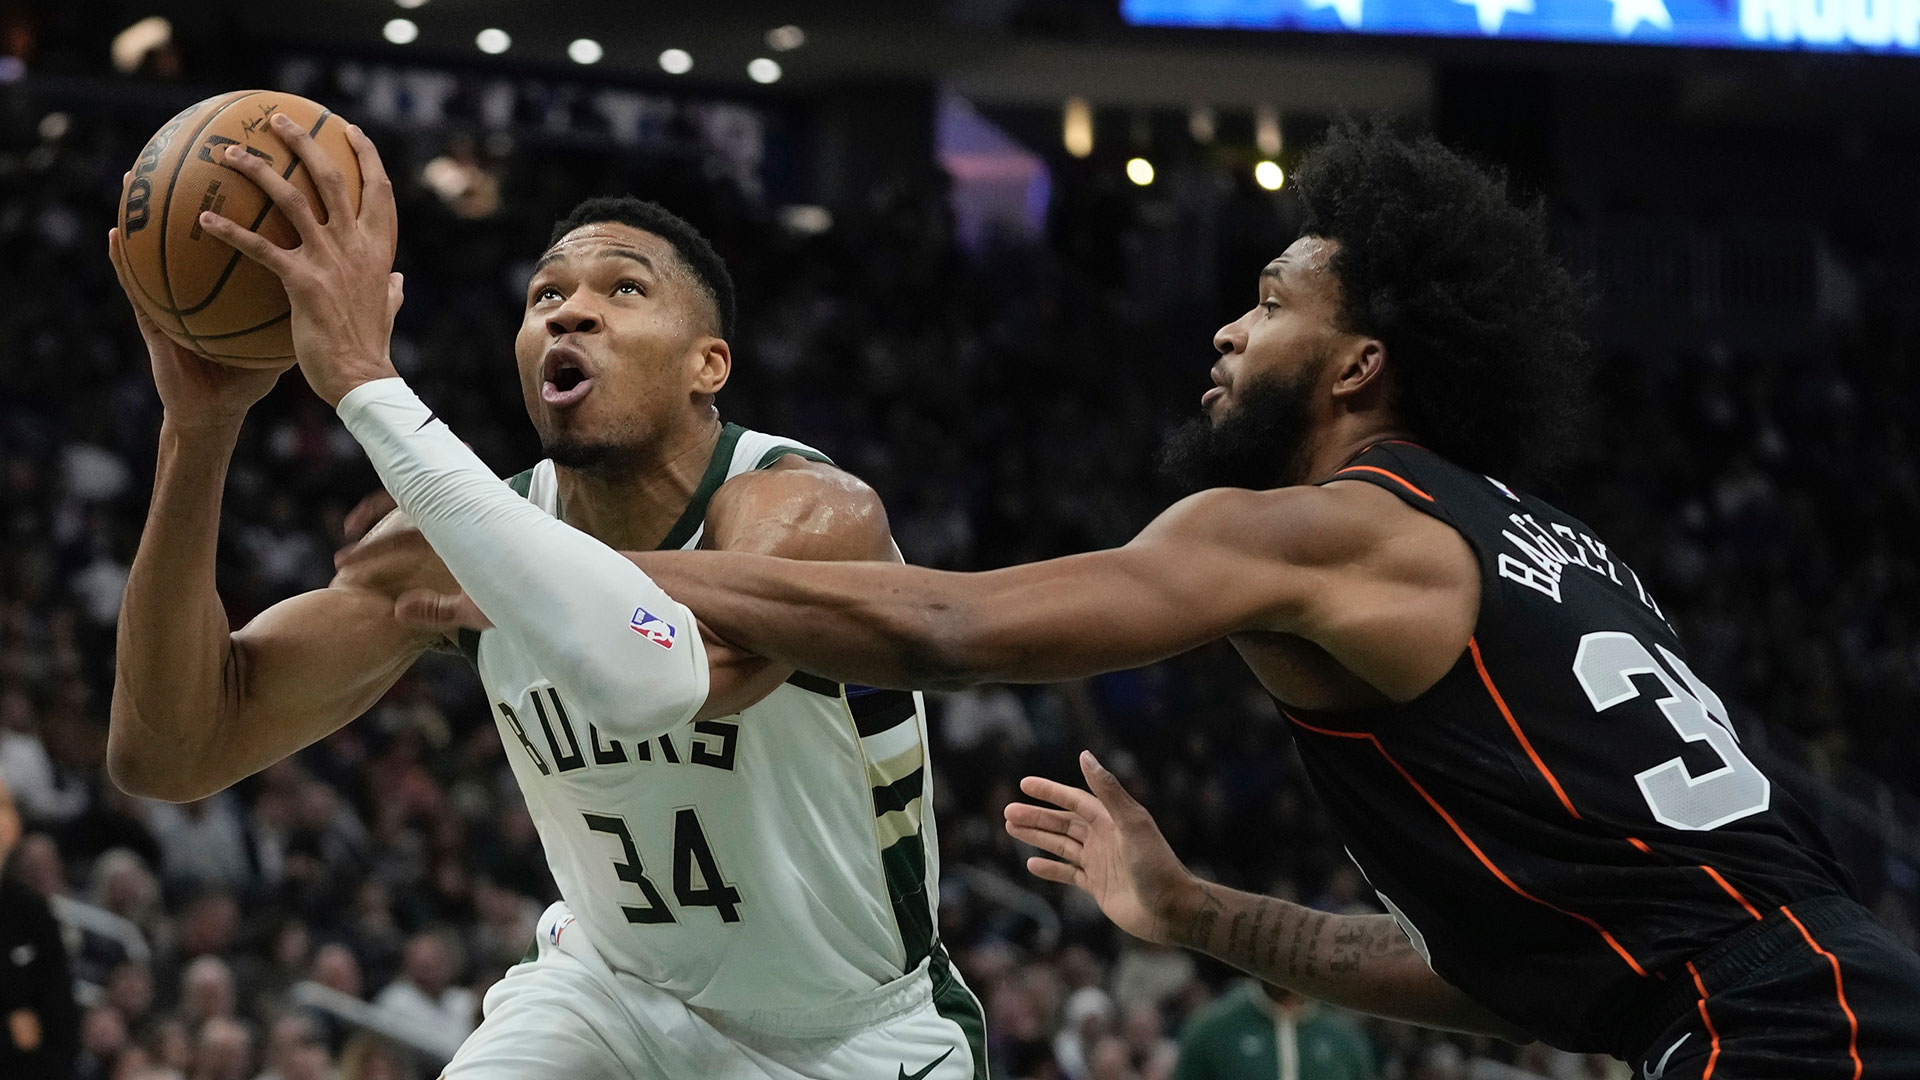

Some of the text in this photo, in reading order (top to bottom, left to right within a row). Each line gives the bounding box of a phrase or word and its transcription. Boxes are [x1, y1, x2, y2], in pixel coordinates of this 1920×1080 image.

[126, 99, 208, 240] Wilso
[1498, 513, 1623, 603] BAGLEY
[580, 806, 744, 925] 34
